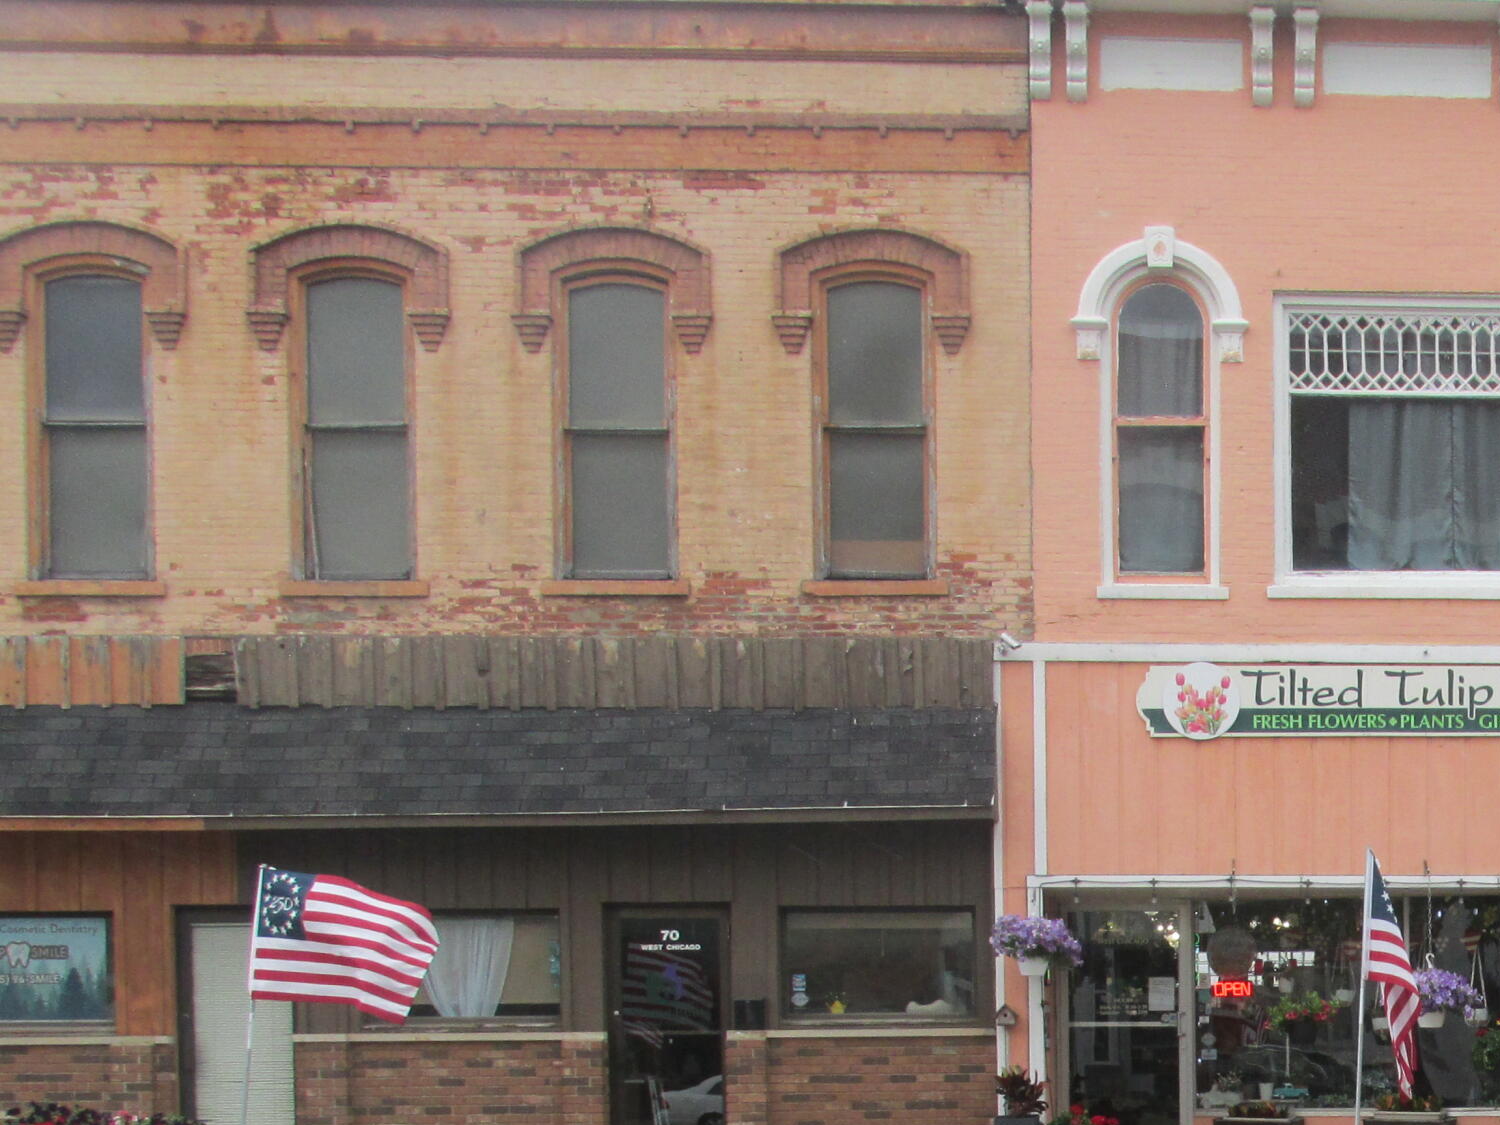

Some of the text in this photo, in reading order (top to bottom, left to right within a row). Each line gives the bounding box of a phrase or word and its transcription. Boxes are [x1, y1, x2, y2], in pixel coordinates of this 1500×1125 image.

[1240, 668, 1364, 708] Tilted
[1384, 668, 1494, 719] Tulip
[1253, 714, 1303, 729] FRESH
[1308, 713, 1387, 729] FLOWERS
[1400, 713, 1465, 729] PLANTS
[50, 922, 98, 936] Dentistry
[660, 930, 680, 941] 70
[31, 946, 68, 959] SMILE
[1214, 982, 1251, 996] OPEN
